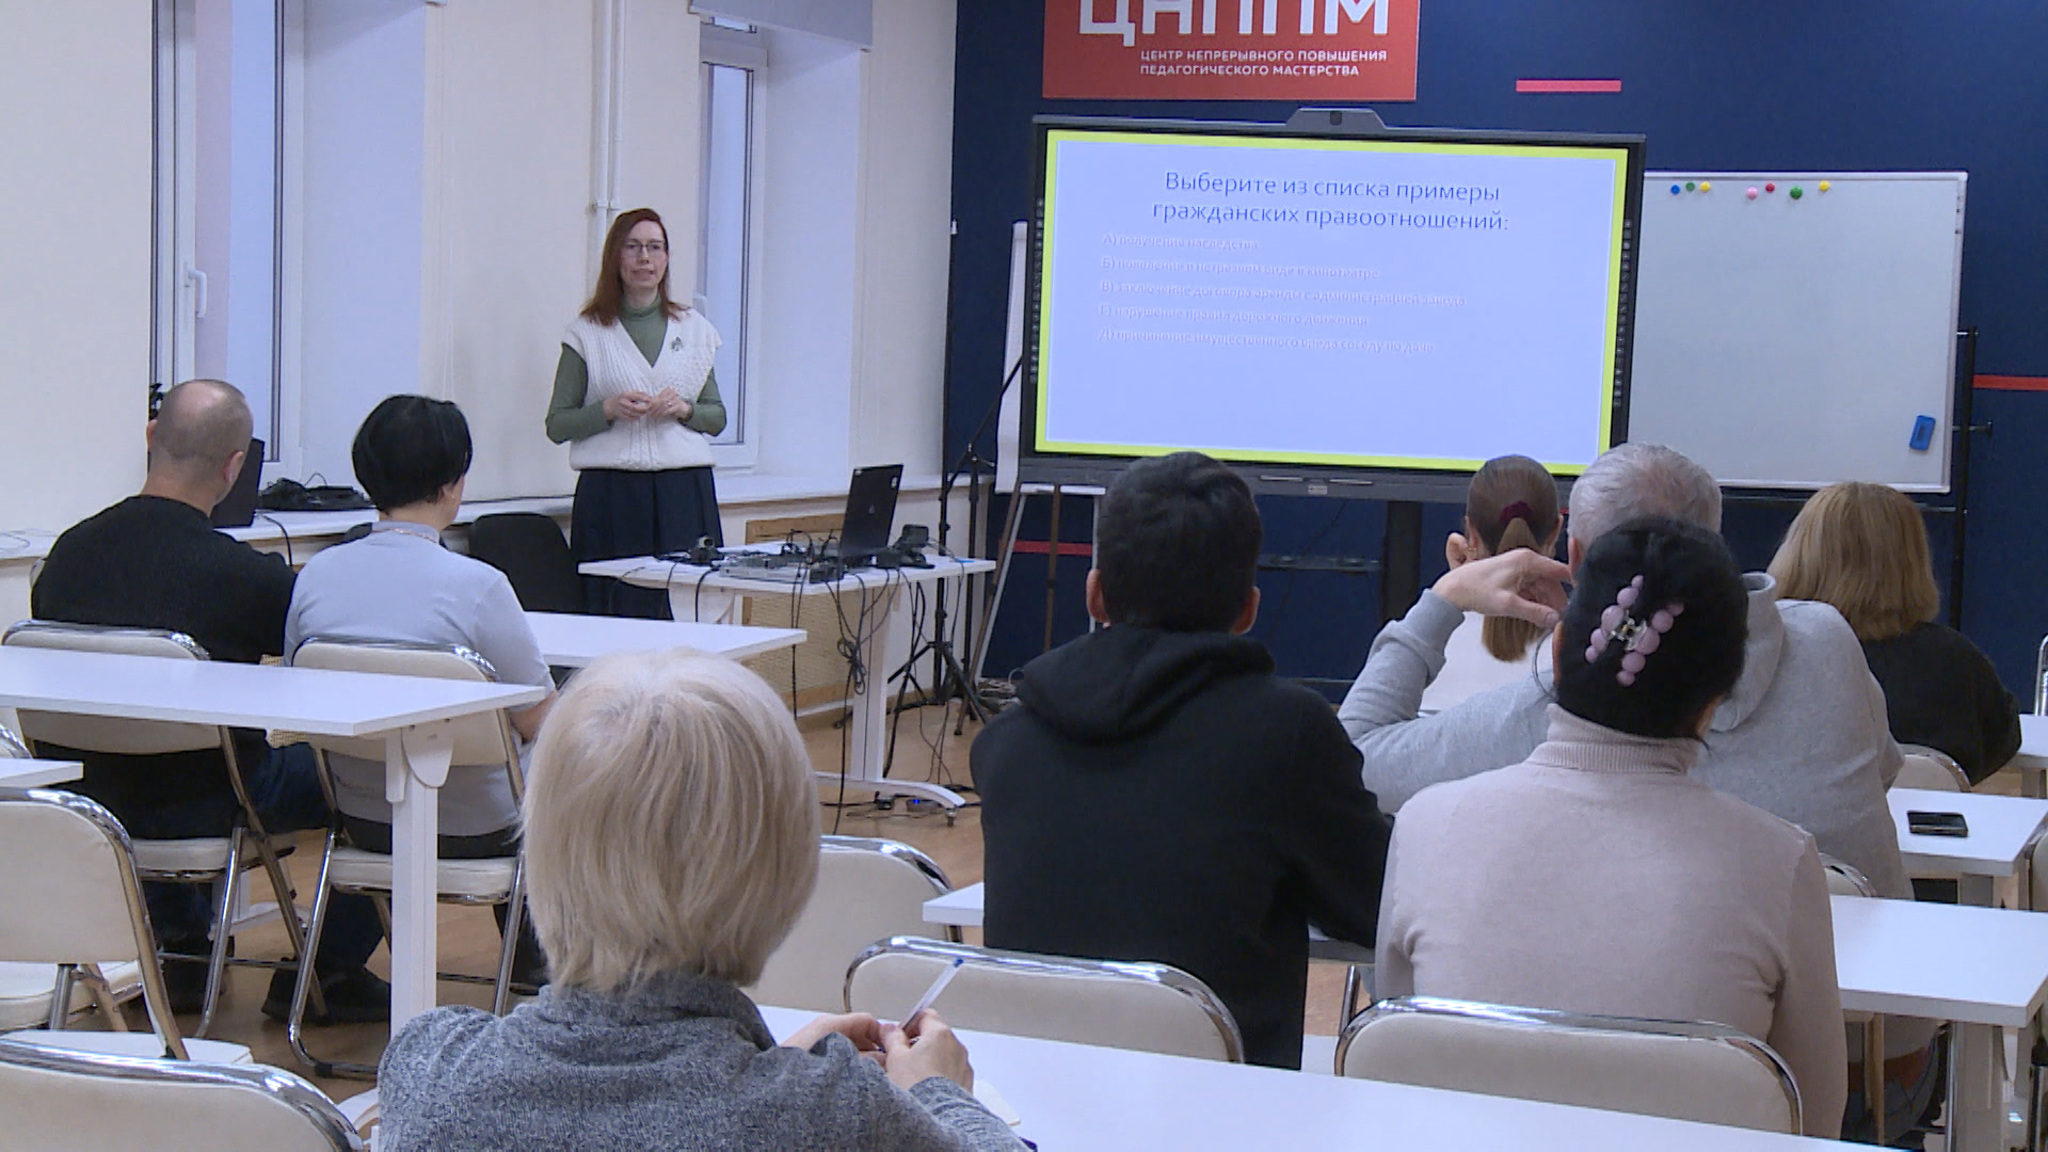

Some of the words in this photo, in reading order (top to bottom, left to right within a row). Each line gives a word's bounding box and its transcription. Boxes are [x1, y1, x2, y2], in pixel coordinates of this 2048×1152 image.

[1140, 50, 1183, 62] ЦЕНТР
[1187, 50, 1295, 62] НЕПРЕРЫВНОГО
[1298, 50, 1388, 62] ПОВЫШЕНИЯ
[1140, 65, 1269, 76] ПЕДАГОГИЧЕСКОГО
[1273, 65, 1360, 76] МАСТЕРСТВА
[1165, 171, 1277, 197] Выберите
[1284, 180, 1308, 195] из
[1314, 181, 1390, 198] списка
[1397, 182, 1501, 202] примеры
[1153, 202, 1299, 223] гражданских
[1306, 209, 1510, 231] правоотношений:
